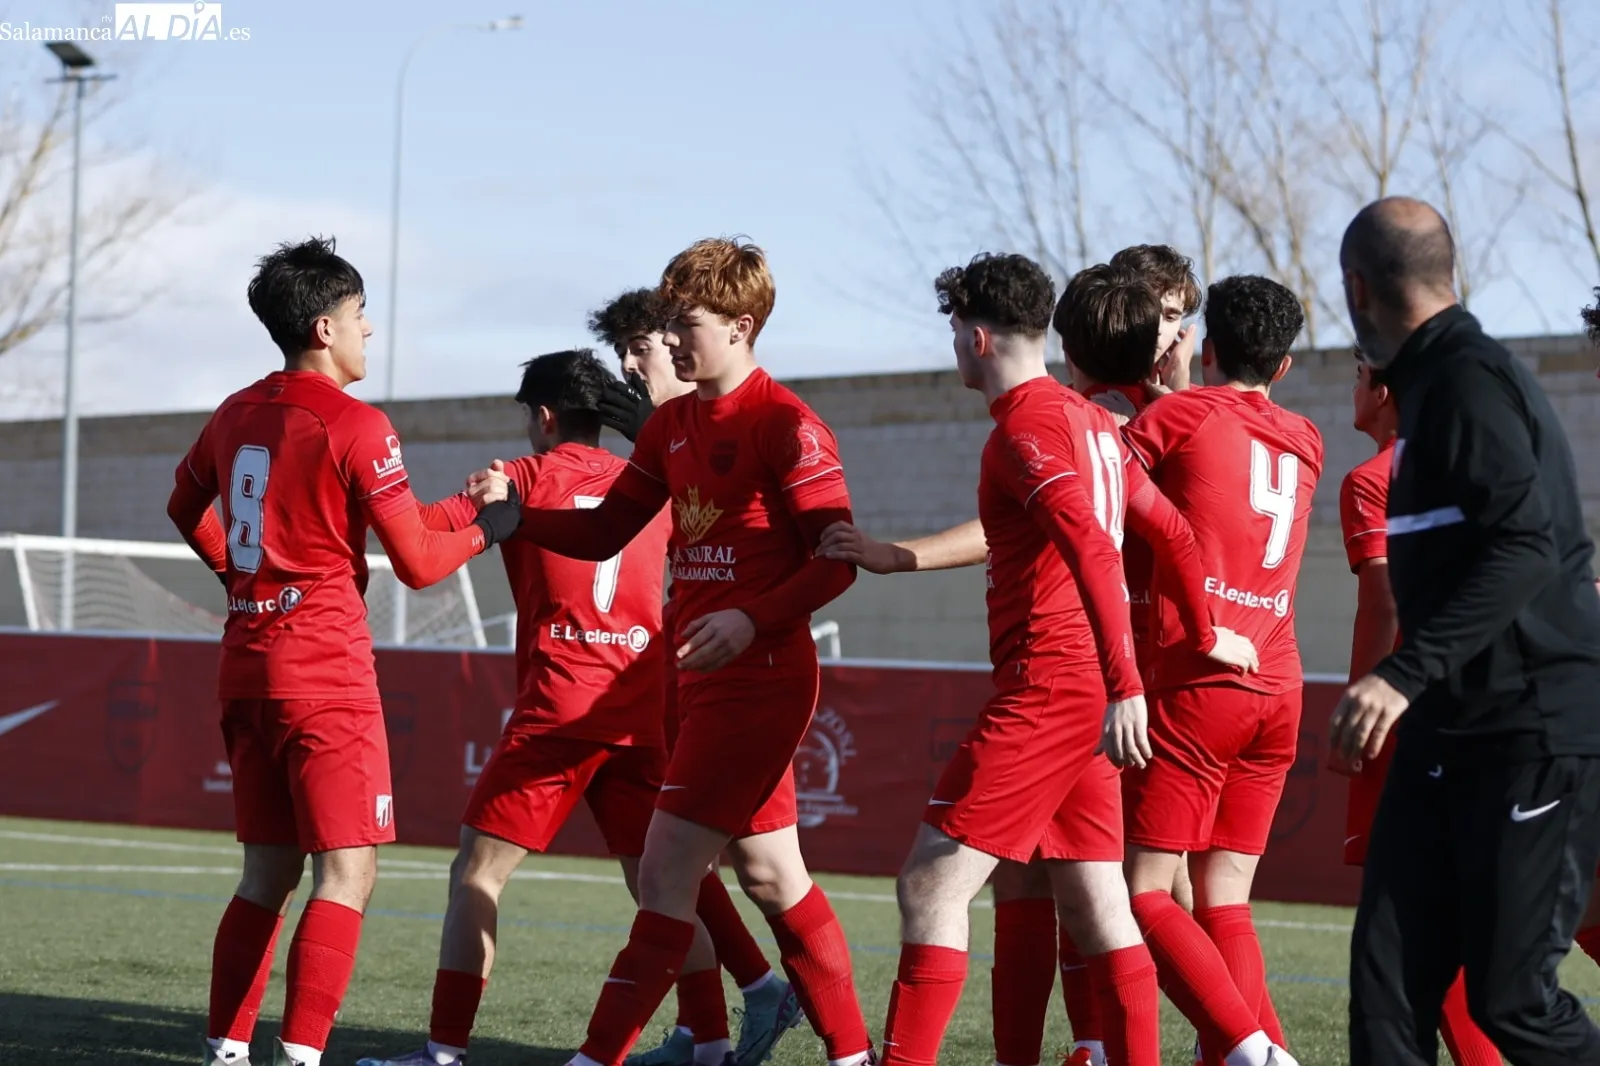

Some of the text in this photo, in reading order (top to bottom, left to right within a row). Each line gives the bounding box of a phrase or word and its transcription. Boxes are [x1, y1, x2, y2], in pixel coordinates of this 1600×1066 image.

[227, 444, 270, 574] 8
[1086, 429, 1124, 551] 10
[1250, 439, 1298, 569] 4
[684, 545, 737, 564] RURAL
[1204, 576, 1274, 609] E.Leclerc
[550, 623, 627, 646] E.Leclerc
